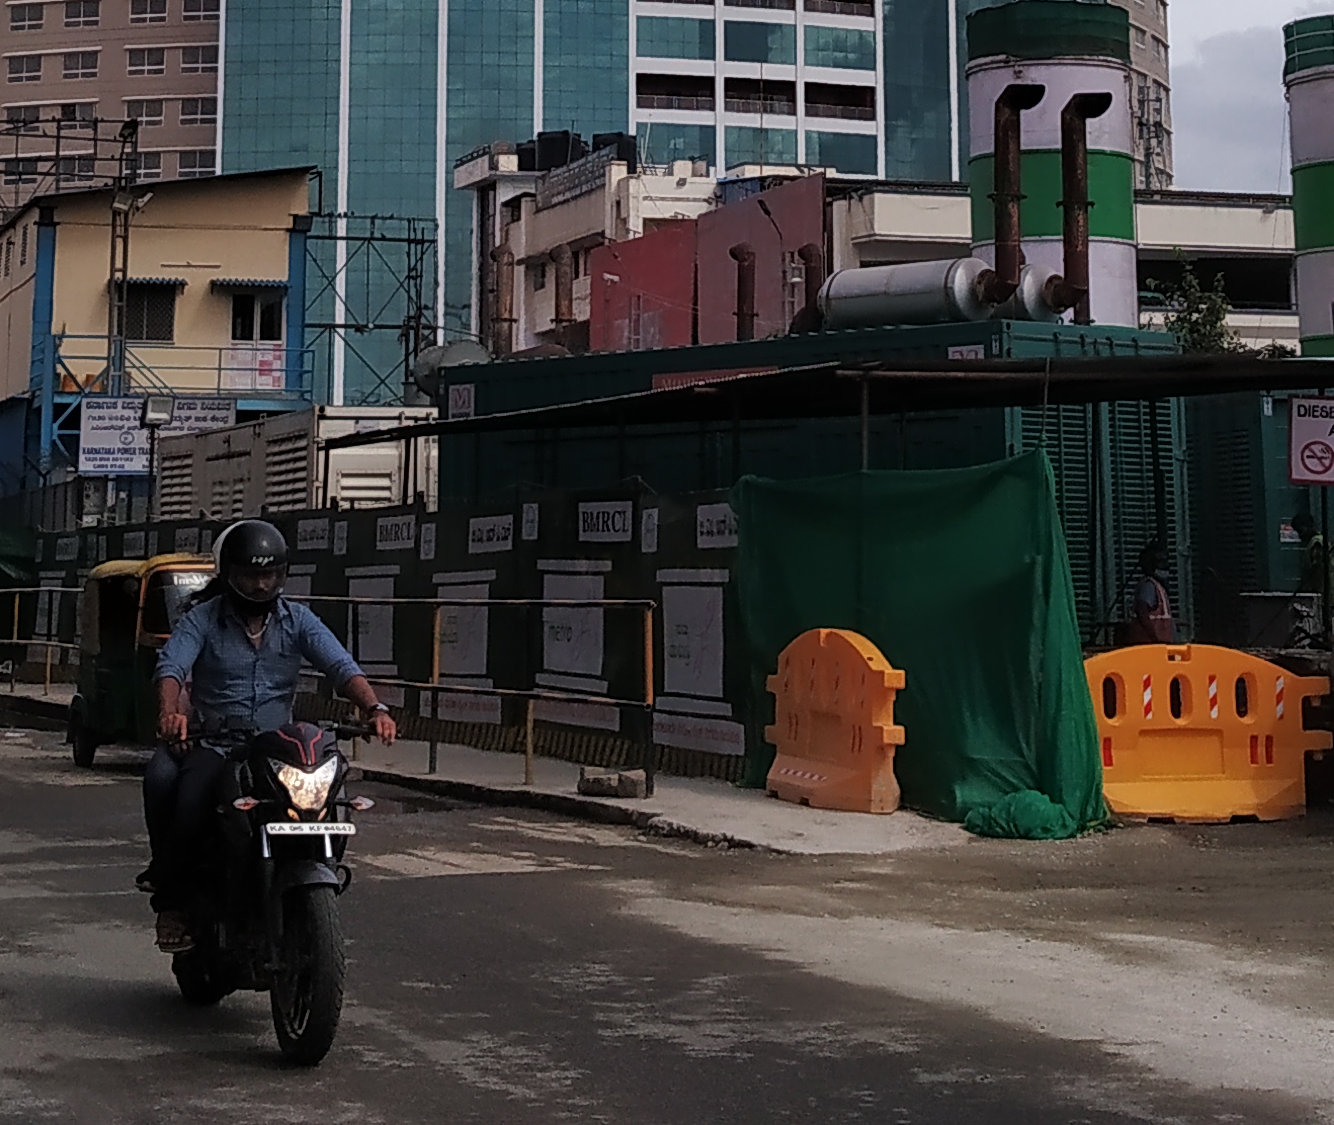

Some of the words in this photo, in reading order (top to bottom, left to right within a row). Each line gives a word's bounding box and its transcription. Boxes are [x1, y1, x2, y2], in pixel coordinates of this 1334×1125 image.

[82, 447, 115, 455] KARNATAKA
[117, 447, 136, 455] POWER
[379, 522, 412, 542] BMRCL
[582, 511, 628, 533] BMRCL
